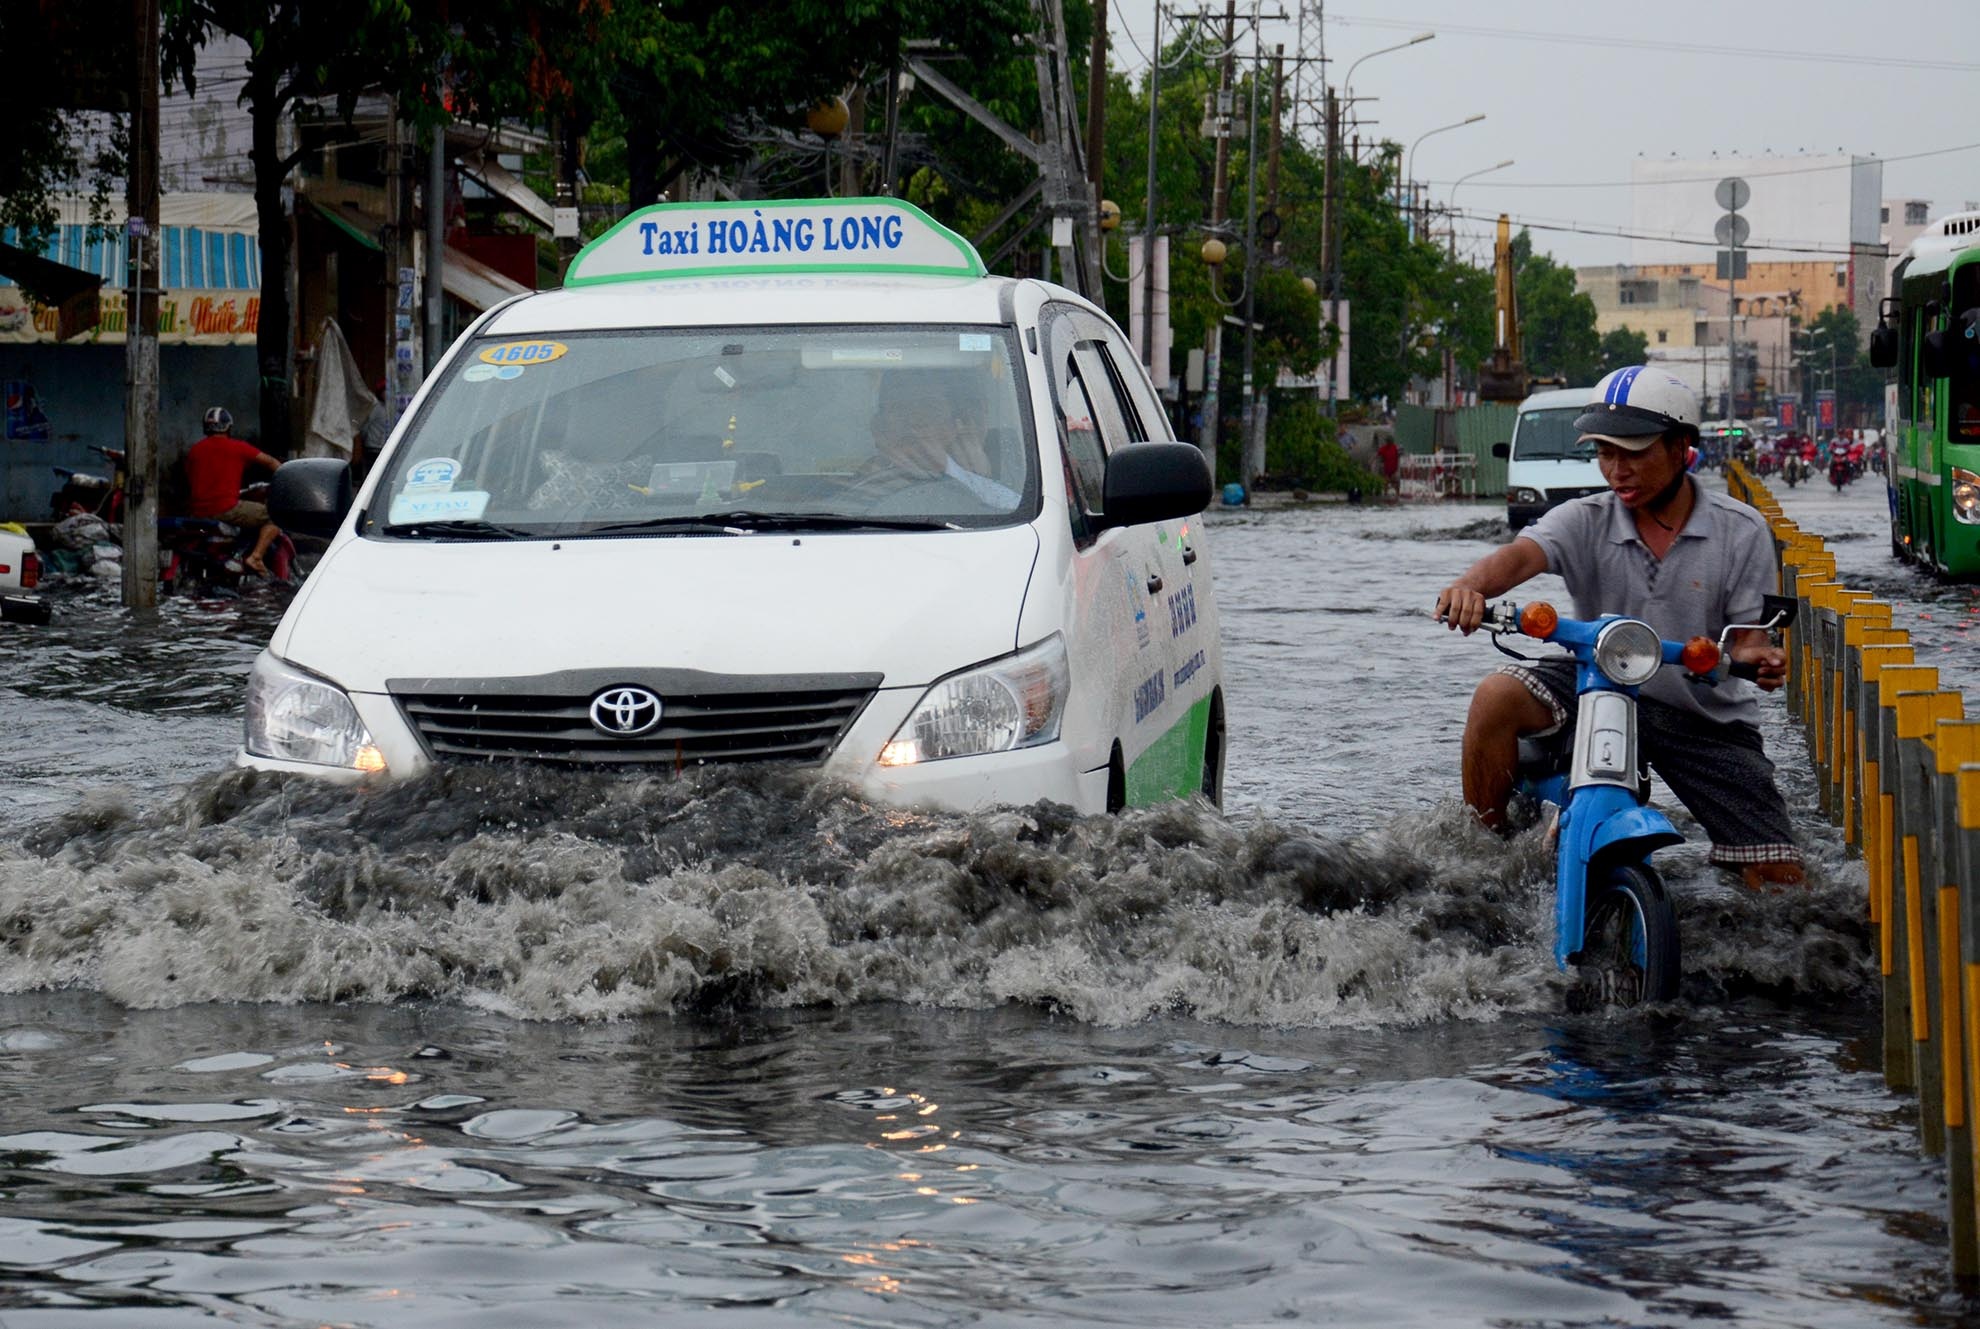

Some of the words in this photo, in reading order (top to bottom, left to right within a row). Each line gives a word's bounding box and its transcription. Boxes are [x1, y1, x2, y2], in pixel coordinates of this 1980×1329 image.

[639, 222, 698, 255] Taxi
[707, 210, 814, 254] HOÀNG
[822, 215, 903, 251] LONG
[491, 344, 556, 361] 4605
